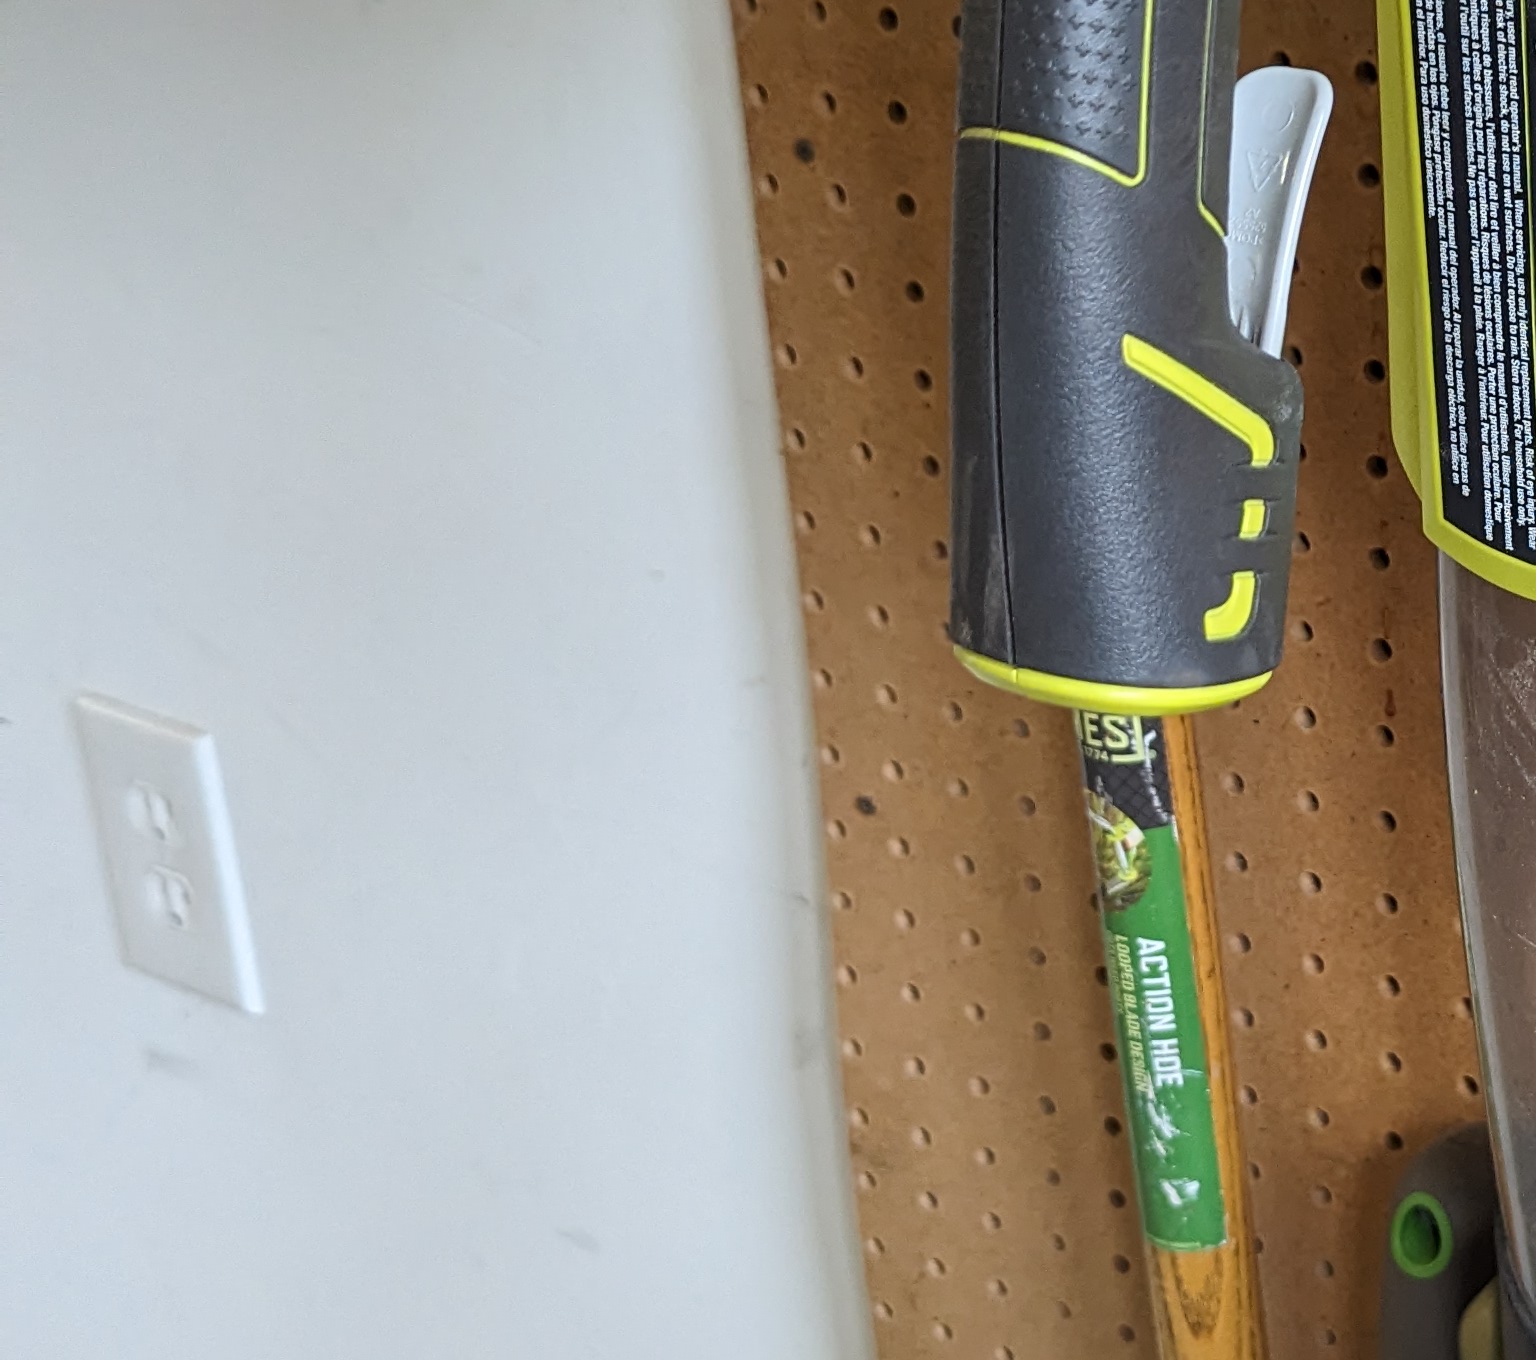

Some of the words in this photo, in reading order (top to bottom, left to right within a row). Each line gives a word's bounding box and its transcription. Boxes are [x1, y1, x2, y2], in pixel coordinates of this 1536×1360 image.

[1415, 8, 1425, 19] el
[1495, 8, 1505, 29] risk
[1478, 13, 1491, 52] risques
[1496, 30, 1505, 42] of
[1507, 21, 1515, 45] user
[1462, 56, 1471, 73] les
[1472, 51, 1482, 82] celles
[1482, 53, 1492, 67] de
[1497, 43, 1507, 82] electric
[1508, 46, 1518, 74] must
[1418, 60, 1429, 84] Para
[1420, 86, 1428, 105] uso
[1463, 74, 1474, 118] surfaces
[1509, 75, 1519, 99] read
[1500, 119, 1509, 133] do
[1473, 129, 1484, 153] pour
[1501, 134, 1510, 152] not
[1477, 154, 1486, 170] les
[1501, 153, 1509, 172] use
[1466, 179, 1476, 198] pas
[1488, 180, 1497, 200] doit
[1502, 173, 1510, 187] on
[1503, 188, 1513, 207] wet
[1467, 199, 1478, 238] exposer
[1489, 201, 1498, 218] lire
[1514, 198, 1524, 227] When
[1489, 219, 1499, 230] et
[1478, 231, 1491, 270] Risques
[1490, 231, 1500, 261] veiller
[1506, 255, 1515, 269] Do
[1483, 271, 1492, 284] de
[1492, 271, 1502, 292] bien
[1507, 270, 1516, 287] not
[1517, 277, 1525, 295] use
[1474, 294, 1483, 304] la
[1505, 288, 1516, 323] expose
[1516, 297, 1528, 318] only
[1491, 293, 1504, 350] comprendre
[1509, 324, 1518, 335] to
[1473, 332, 1486, 366] Ranger
[1519, 319, 1529, 360] identical
[1495, 351, 1505, 361] le
[1487, 367, 1497, 395] Porter
[1496, 362, 1506, 397] manuel
[1510, 358, 1520, 384] Store
[1518, 361, 1532, 419] replacement
[1480, 422, 1490, 443] Pour
[1487, 415, 1500, 461] protection
[1513, 423, 1523, 439] For
[1481, 444, 1492, 488] utilisation
[1514, 440, 1525, 487] household
[1524, 447, 1534, 468] Risk
[1500, 454, 1511, 486] Utiliser
[1525, 469, 1534, 479] of
[1523, 480, 1533, 496] eye
[1481, 489, 1494, 541] domestique
[1493, 501, 1503, 522] Pour
[1502, 487, 1514, 550] exclusivement
[1527, 526, 1536, 549] Wear
[1115, 934, 1136, 991] LOOPED
[1136, 937, 1177, 1033] ACTION
[1123, 993, 1142, 1039] BLADE
[1130, 1040, 1149, 1093] DESIGN
[1150, 1038, 1184, 1088] HOE
